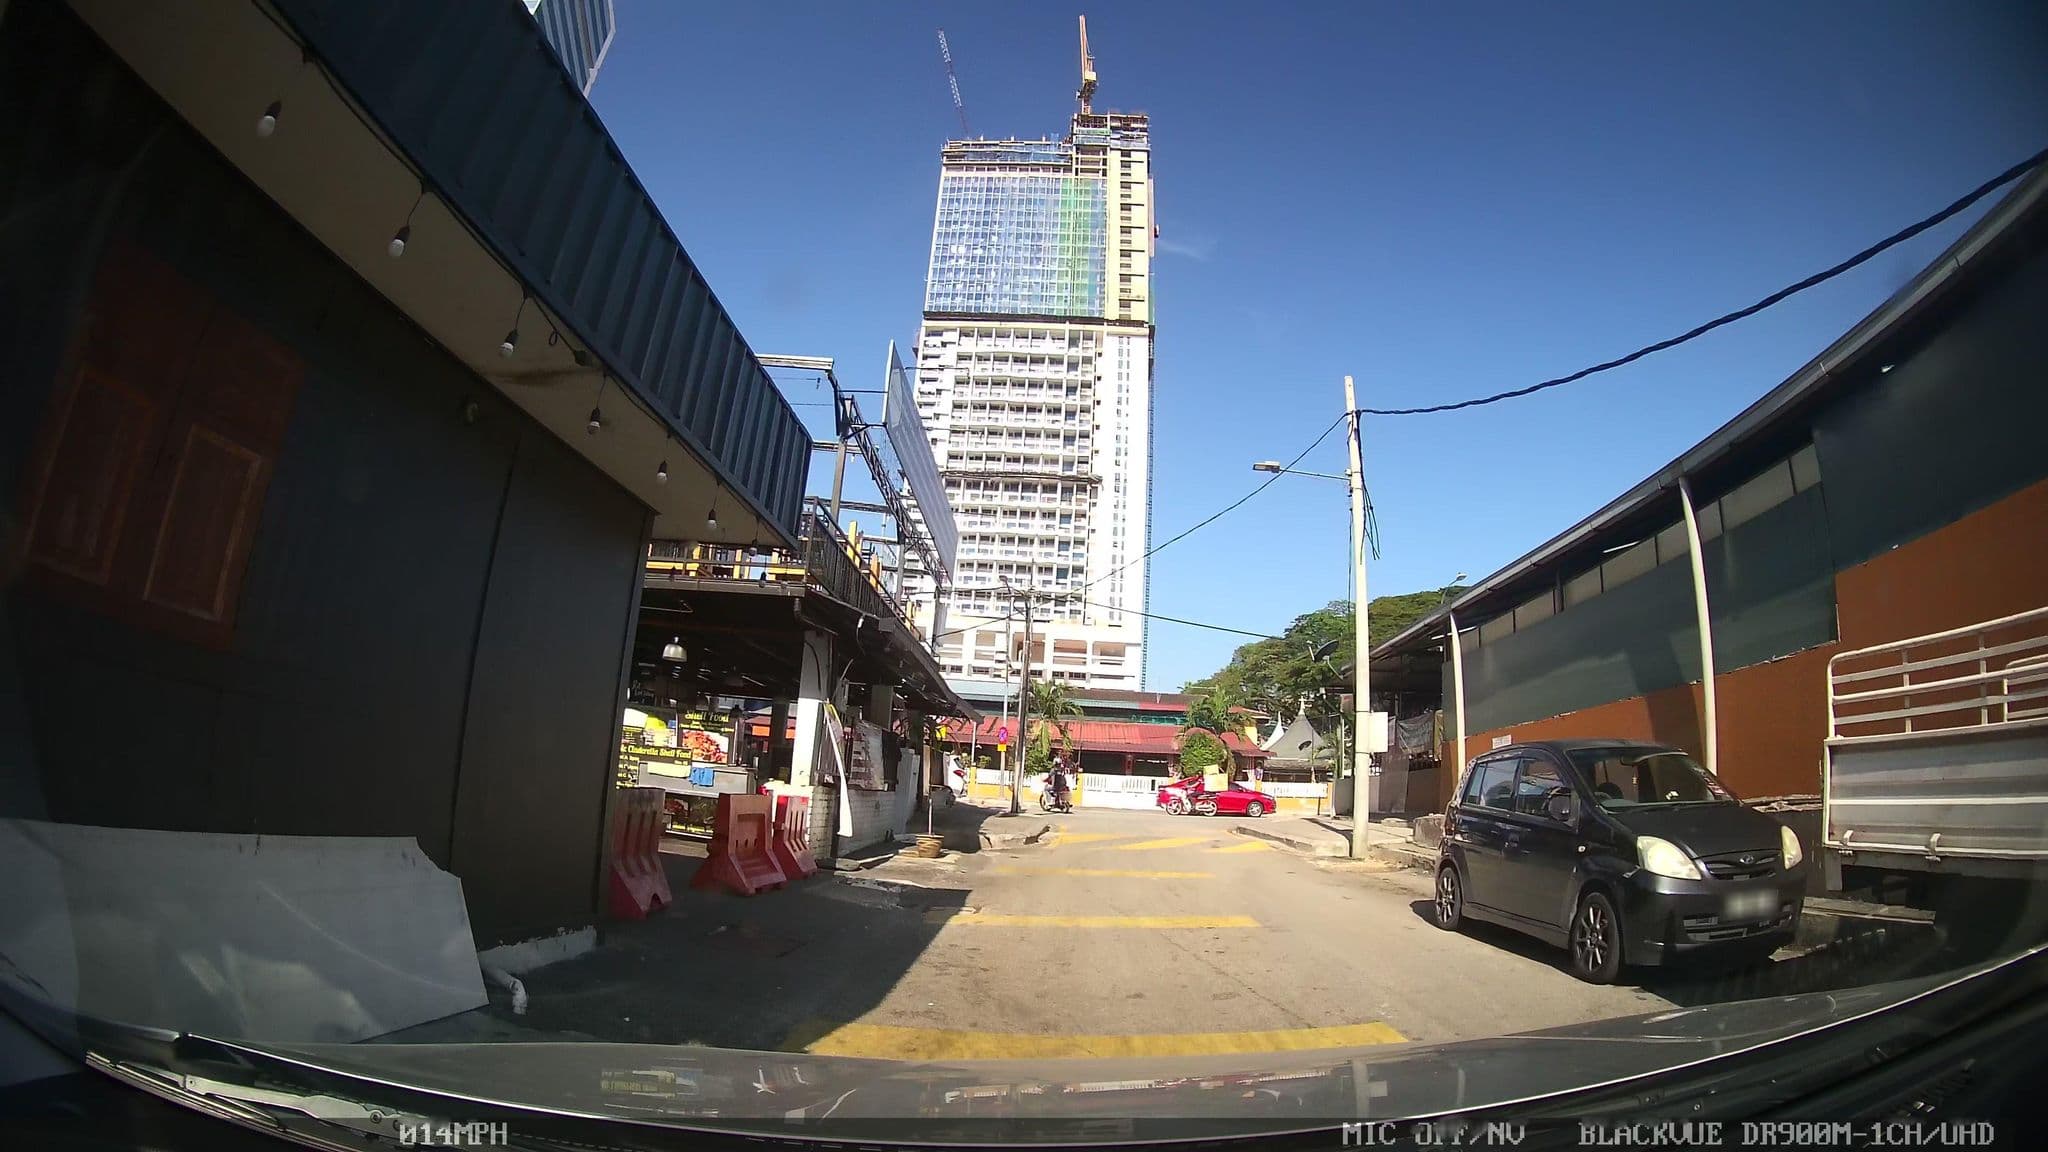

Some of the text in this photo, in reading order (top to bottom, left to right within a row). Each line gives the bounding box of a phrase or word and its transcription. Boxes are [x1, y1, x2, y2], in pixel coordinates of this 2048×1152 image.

[628, 745, 658, 756] Cinderella
[659, 747, 675, 757] Shell
[676, 749, 691, 759] Food
